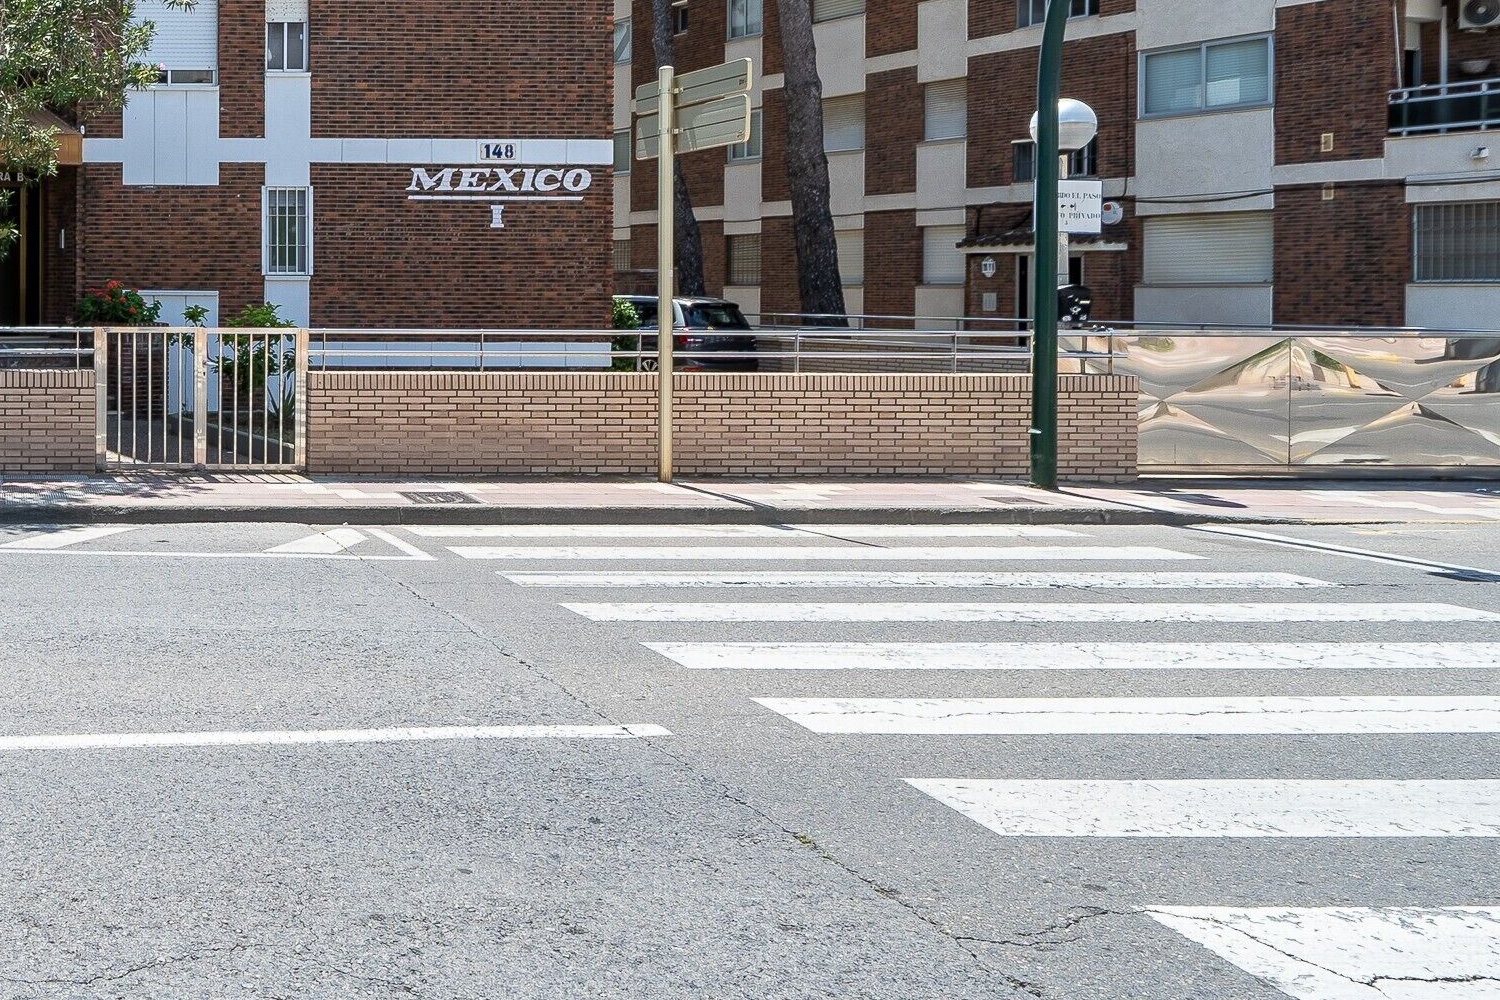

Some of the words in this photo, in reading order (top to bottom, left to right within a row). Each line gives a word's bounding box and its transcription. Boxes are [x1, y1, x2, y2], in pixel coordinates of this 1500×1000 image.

[483, 144, 515, 159] 148
[17, 172, 24, 182] B
[405, 167, 592, 192] MEXICO
[490, 204, 505, 228] I
